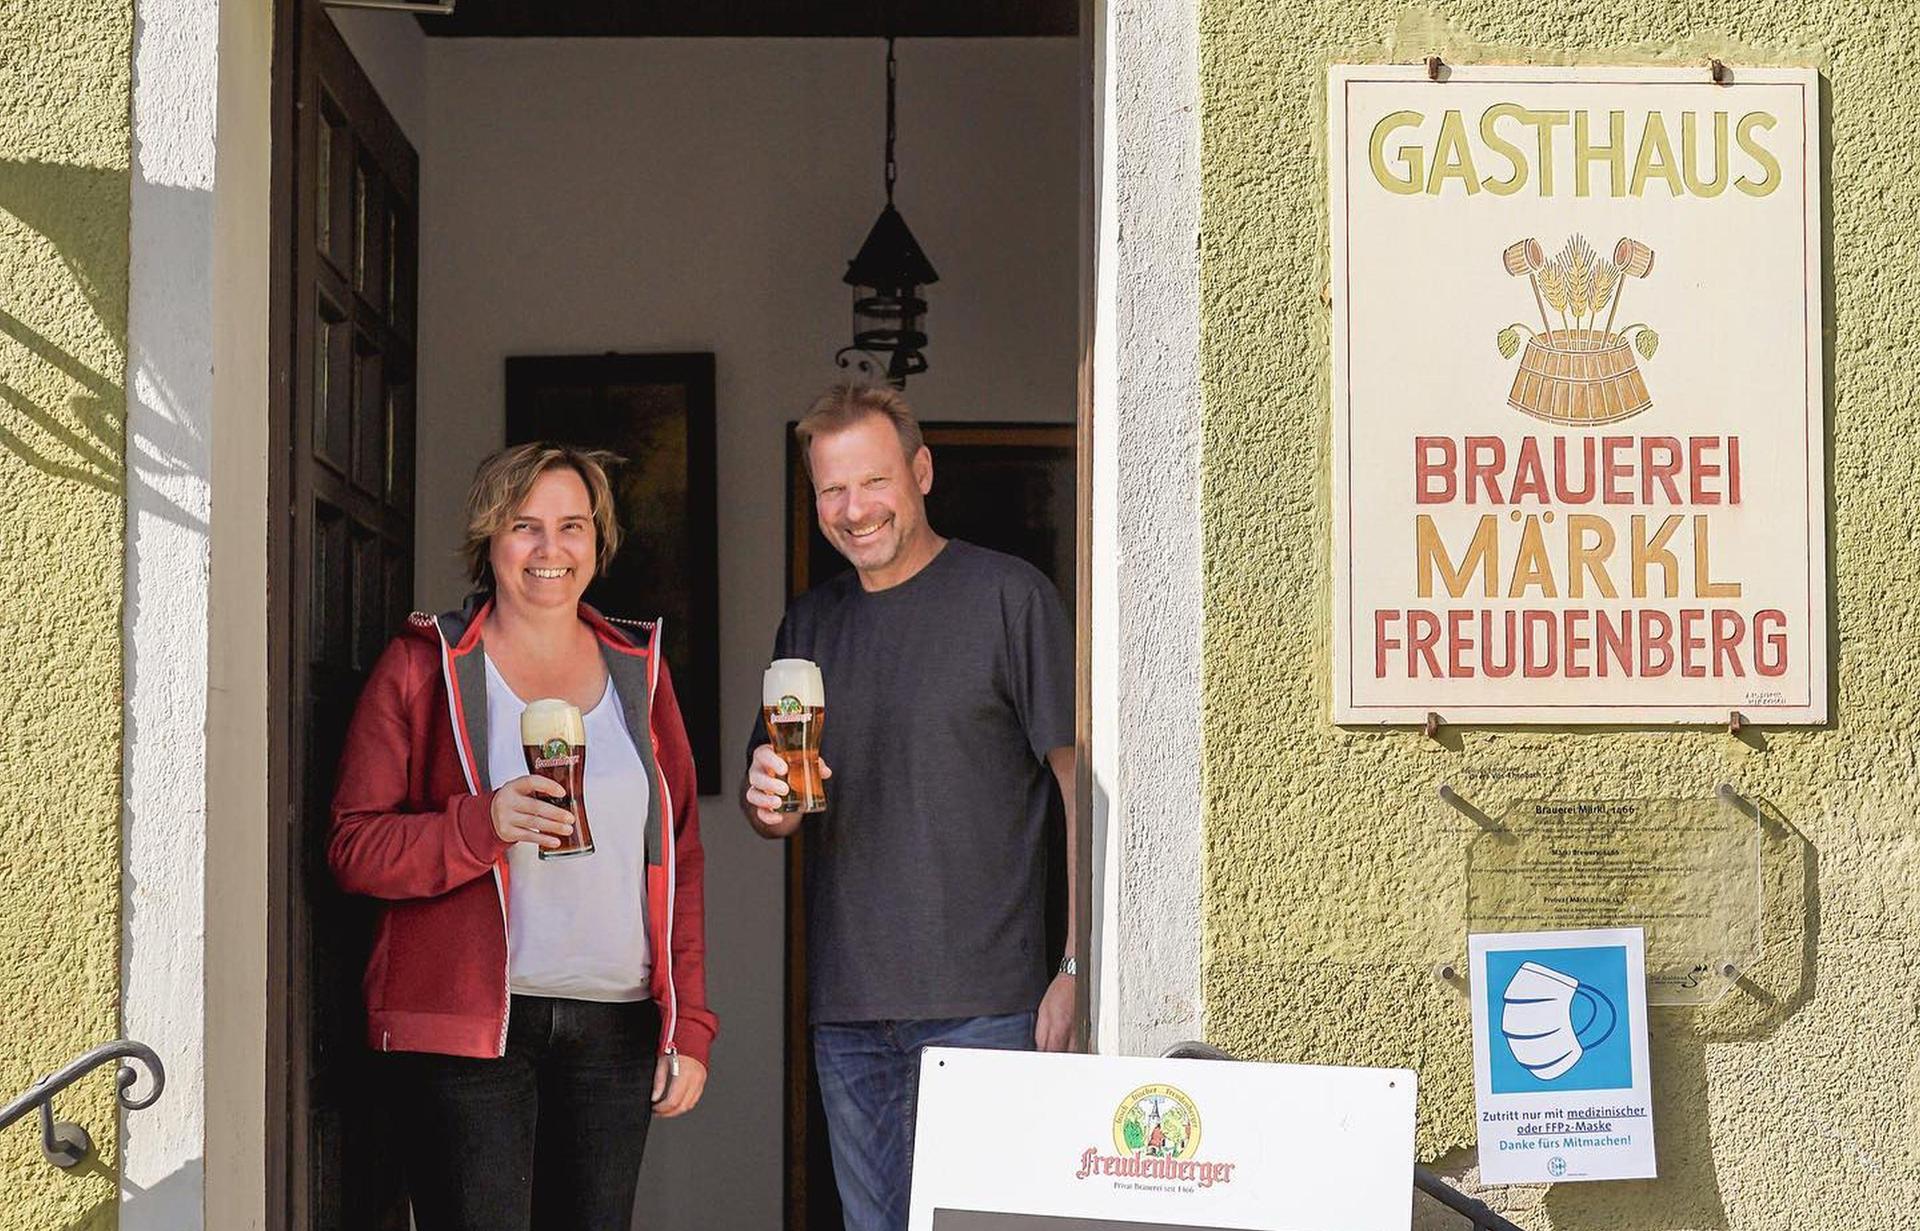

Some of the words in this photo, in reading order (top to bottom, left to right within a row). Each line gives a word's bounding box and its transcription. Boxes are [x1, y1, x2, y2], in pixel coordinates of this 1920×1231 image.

[1369, 103, 1783, 198] GASTHAUS
[1415, 435, 1741, 505] BRAUEREI
[1415, 510, 1742, 599] MÄRKL
[1374, 609, 1788, 678] FREUDENBERG
[1536, 804, 1576, 814] Brauerei
[1578, 804, 1609, 815] Märkl,
[1482, 1110, 1520, 1122] Zutritt
[1522, 1111, 1542, 1120] nur
[1544, 1108, 1564, 1119] mit
[1567, 1105, 1647, 1119] medizinischer
[1517, 1123, 1542, 1134] oder
[1545, 1120, 1612, 1134] FFP2-Maske
[1499, 1139, 1535, 1151] Danke
[1538, 1137, 1560, 1149] fürs
[1563, 1135, 1632, 1148] Mitmachen!
[1075, 1146, 1236, 1188] Freudenberger
[1134, 1183, 1163, 1192] Brauerei
[1164, 1184, 1176, 1193] seit
